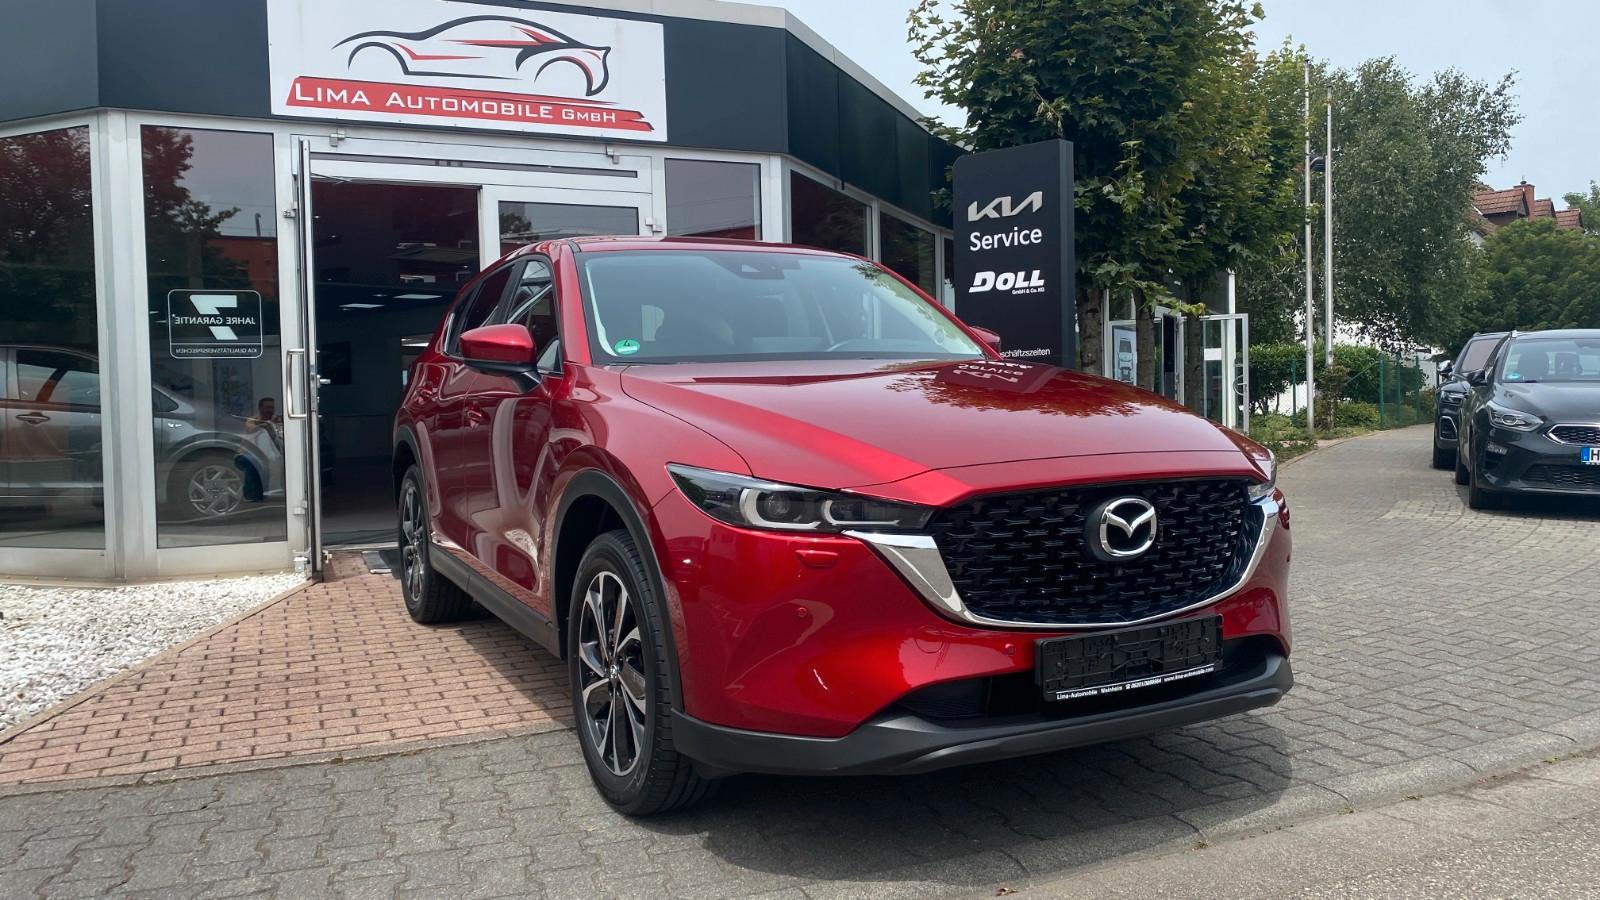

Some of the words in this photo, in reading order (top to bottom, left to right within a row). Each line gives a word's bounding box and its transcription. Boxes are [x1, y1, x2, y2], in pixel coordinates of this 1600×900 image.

[967, 191, 1042, 221] KIA
[970, 227, 1042, 251] Service
[968, 270, 1045, 293] DOLL
[623, 339, 631, 347] 4
